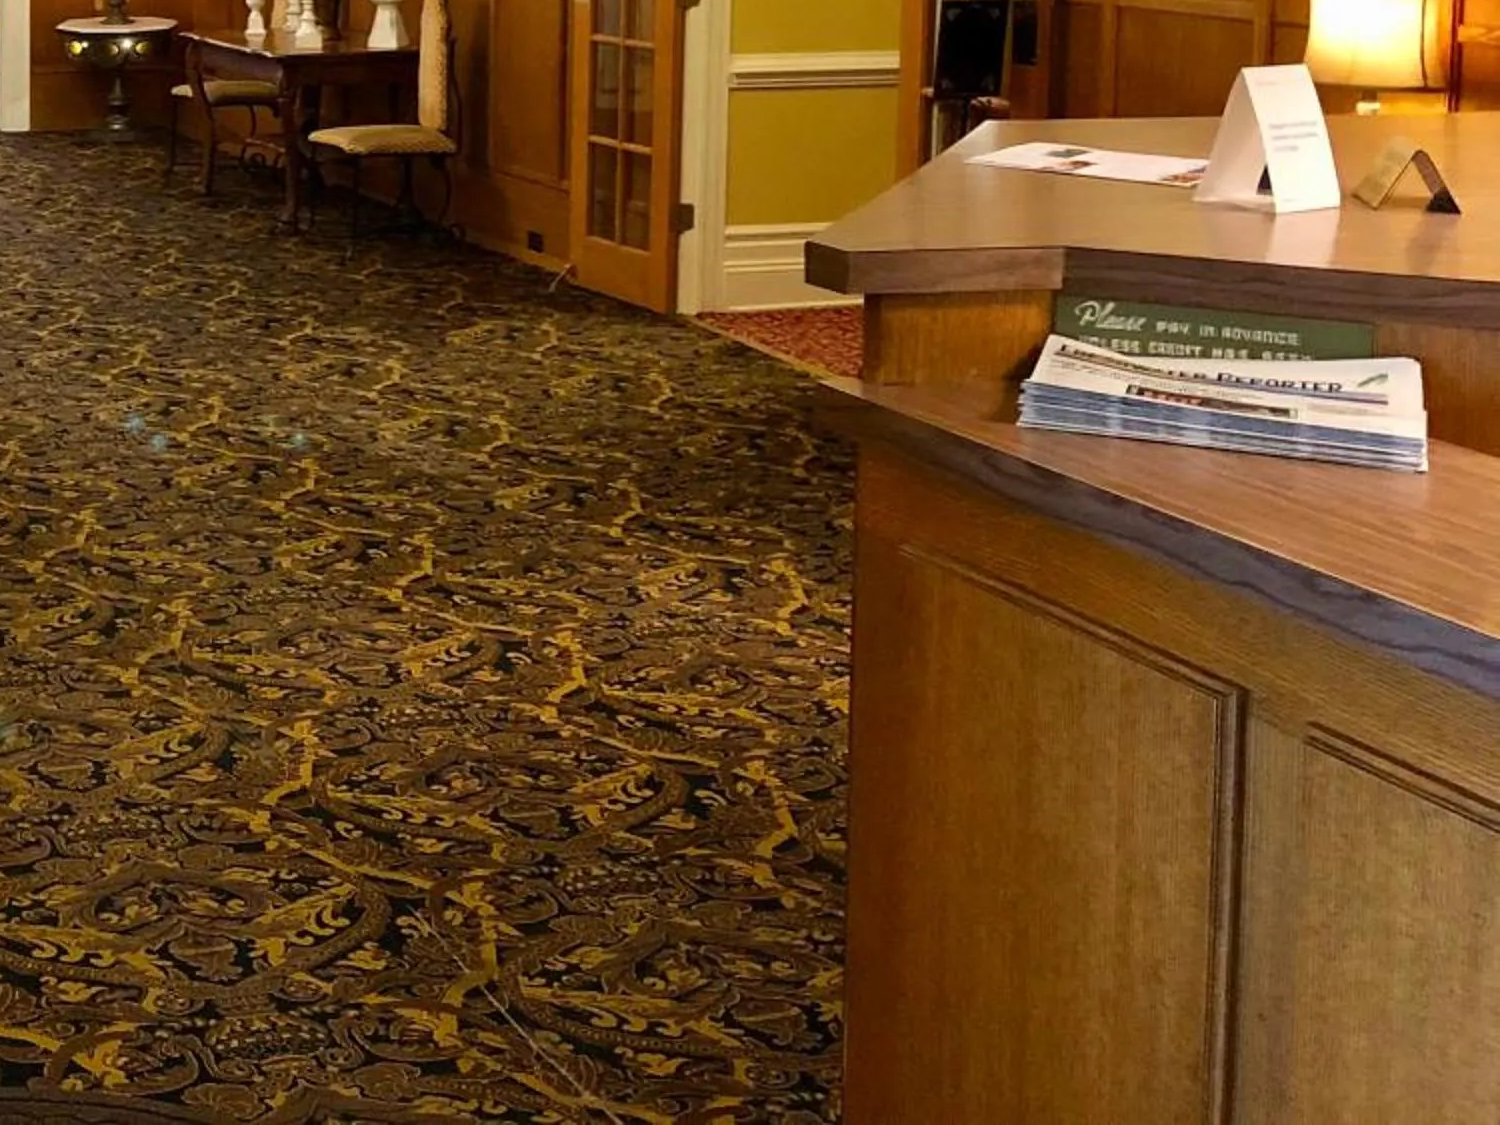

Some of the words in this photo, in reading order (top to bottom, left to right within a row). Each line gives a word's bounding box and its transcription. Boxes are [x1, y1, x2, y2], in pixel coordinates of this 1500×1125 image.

[1074, 300, 1148, 332] Please
[1156, 320, 1190, 335] PAY
[1221, 326, 1300, 346] ADVANCE
[1148, 341, 1204, 356] CREDIT
